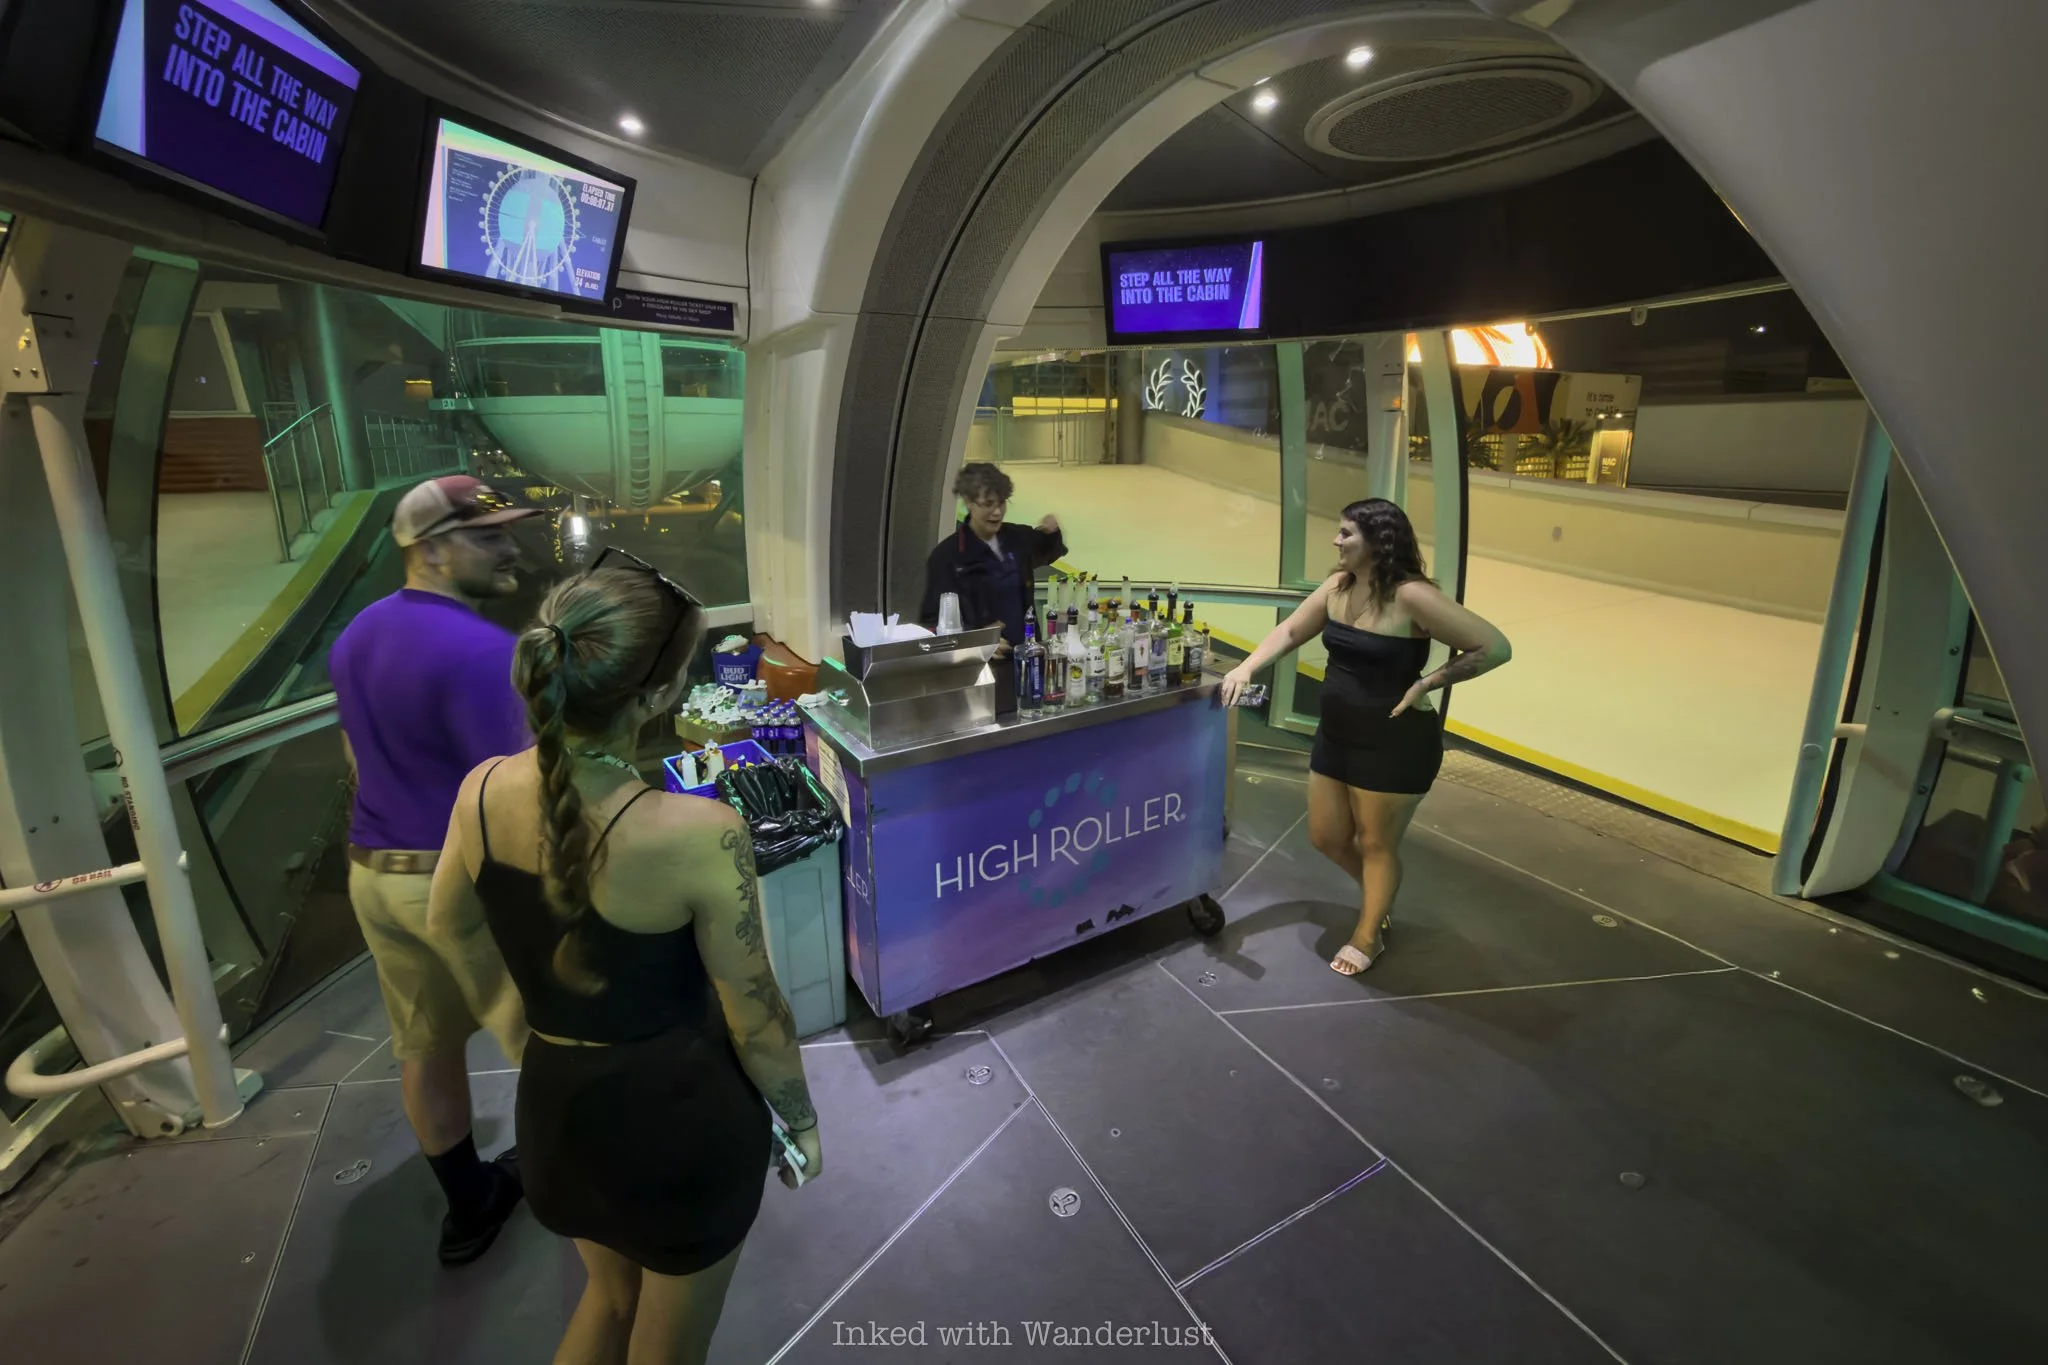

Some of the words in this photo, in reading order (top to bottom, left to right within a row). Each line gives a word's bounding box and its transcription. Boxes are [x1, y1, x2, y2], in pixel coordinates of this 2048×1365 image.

[174, 4, 232, 60] STEP
[232, 43, 265, 88] ALL
[270, 65, 303, 109] THE
[303, 88, 338, 130] WAY
[163, 43, 225, 108] INTO
[229, 80, 272, 133] THE
[272, 108, 328, 164] CABIN
[1120, 272, 1149, 288] STEP
[1153, 270, 1174, 286] ALL
[1176, 269, 1200, 285] THE
[1203, 267, 1233, 283] WAY
[1121, 288, 1152, 305] INTO
[1156, 286, 1183, 303] THE
[1187, 284, 1231, 302] CABIN
[720, 673, 749, 681] LIGHT
[935, 833, 1038, 898] HIGH
